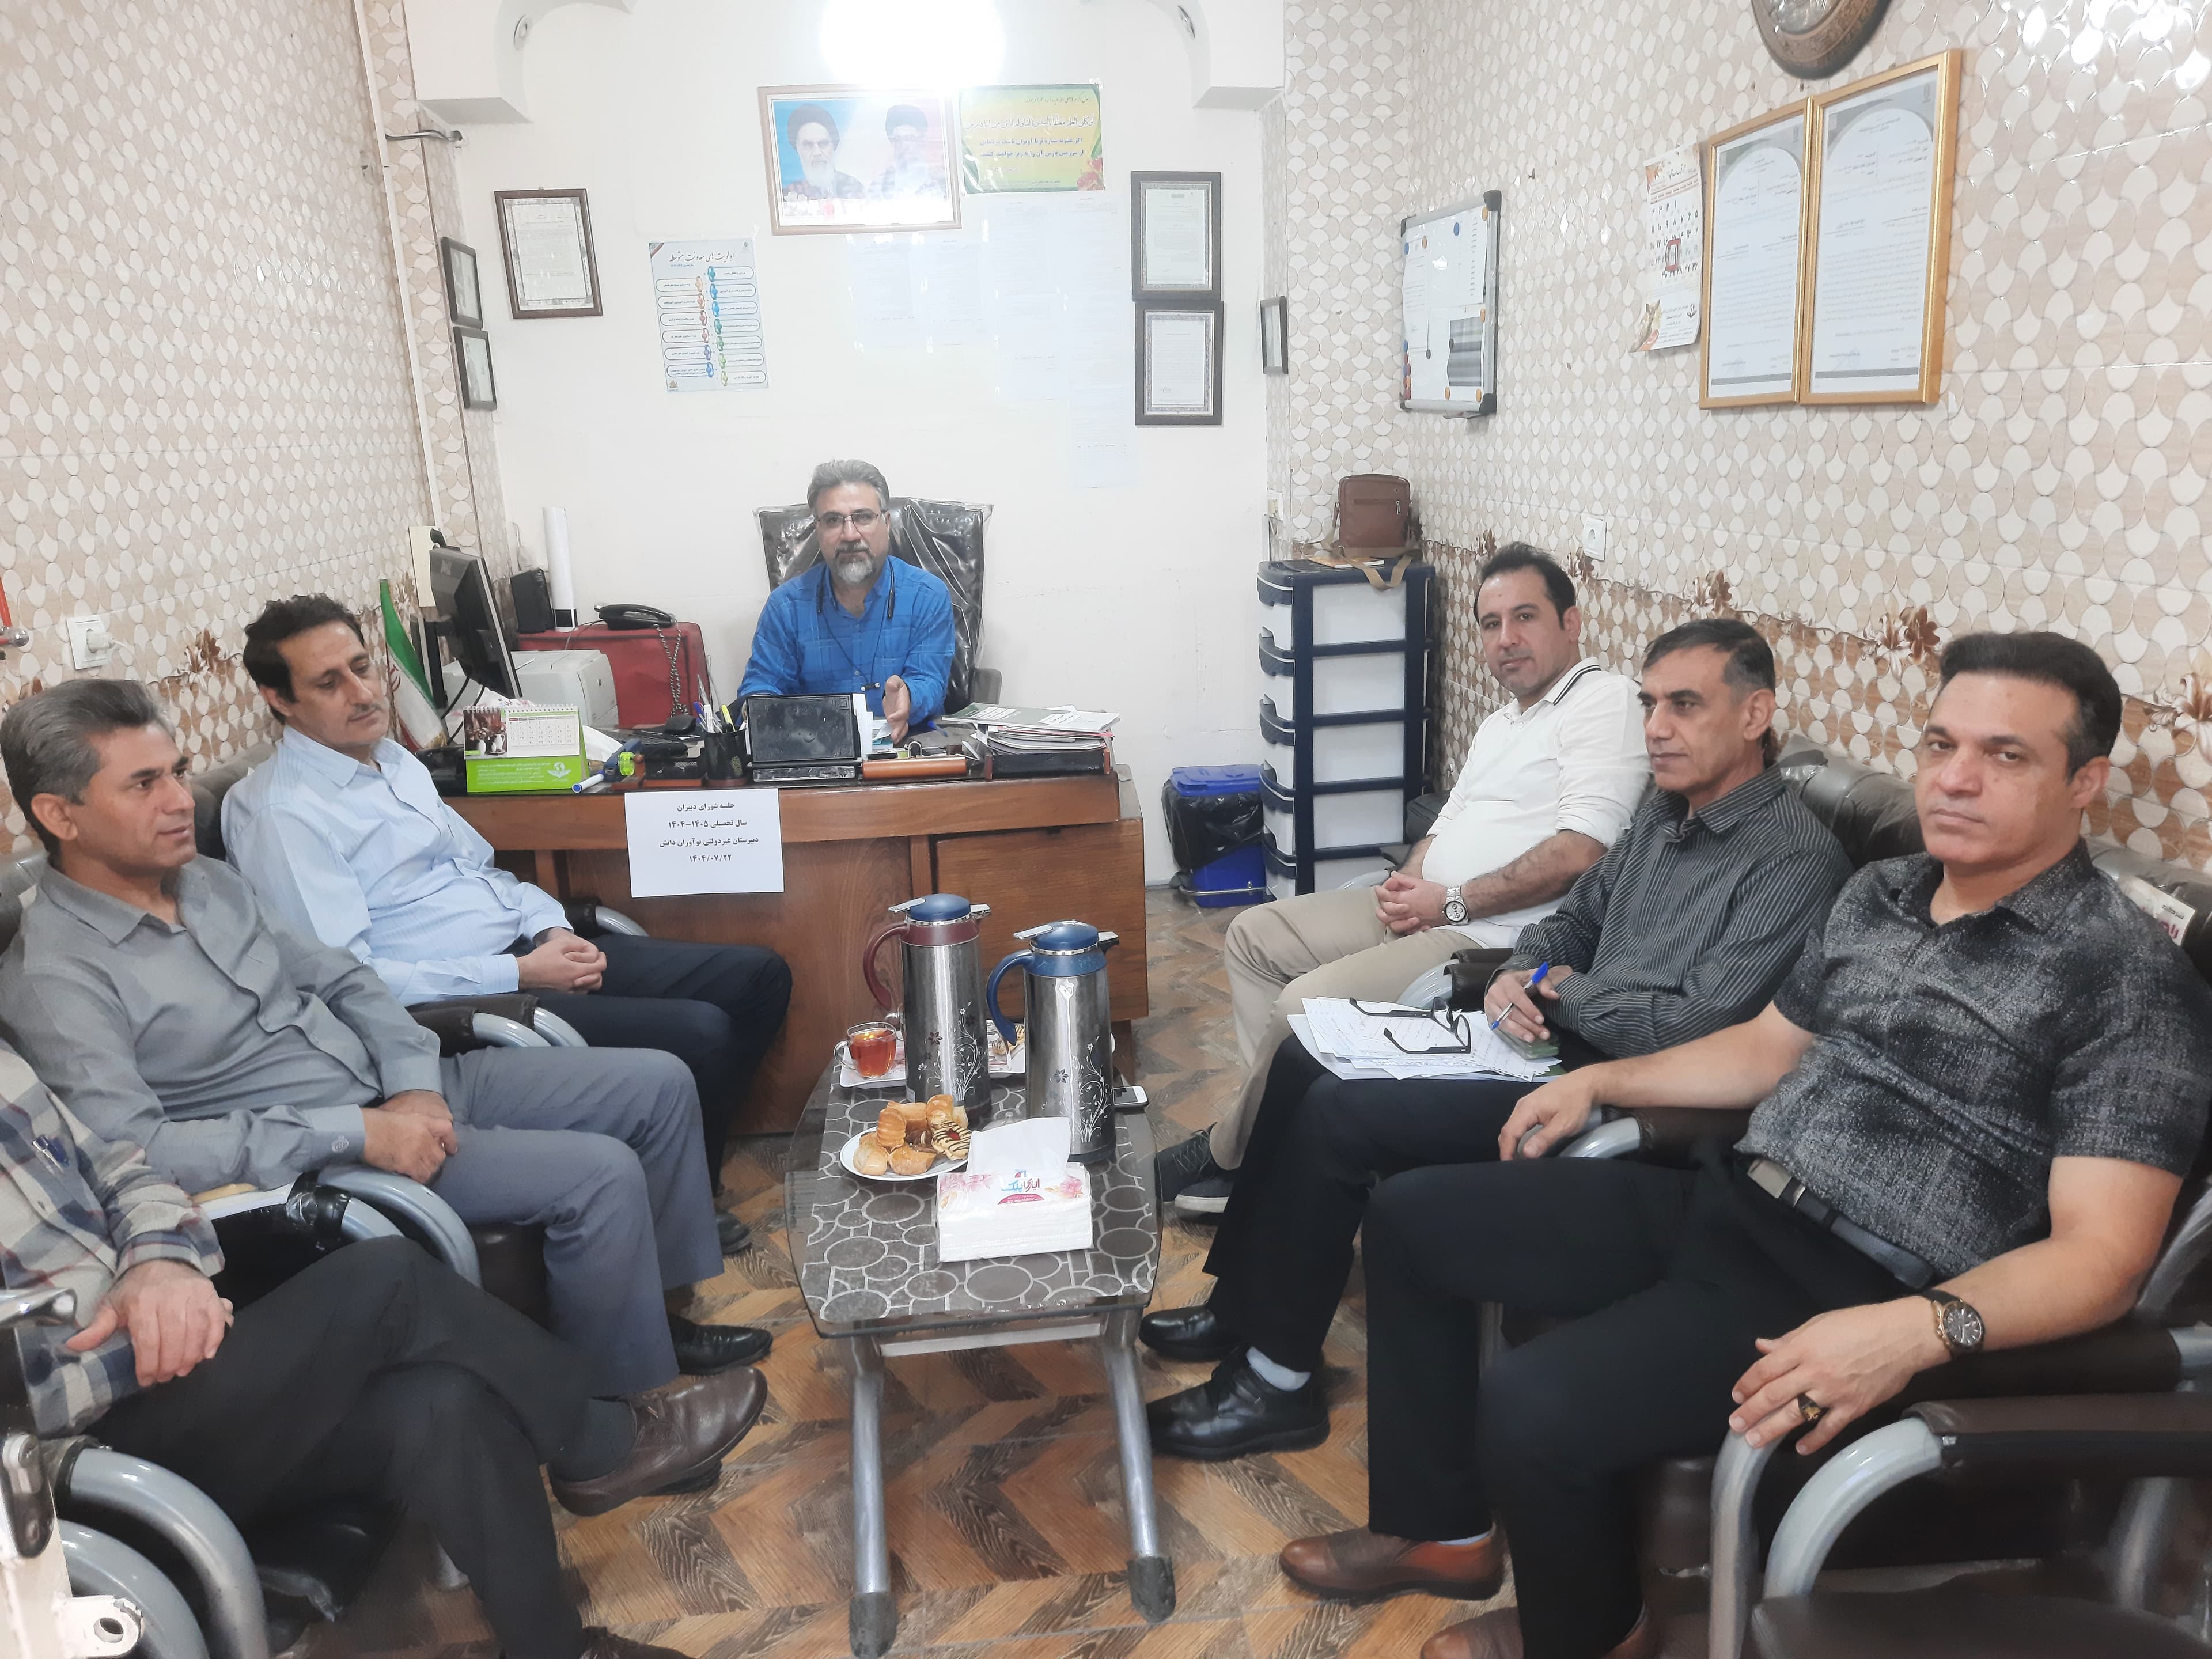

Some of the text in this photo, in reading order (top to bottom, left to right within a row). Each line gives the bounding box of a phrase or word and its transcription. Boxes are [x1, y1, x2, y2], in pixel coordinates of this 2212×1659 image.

[677, 802, 735, 812] جلسه شورای دبیران
[710, 819, 734, 828] تحصیلی
[735, 819, 747, 827] سال
[659, 839, 676, 847] دانش
[732, 836, 759, 845] دبیرستان
[689, 854, 732, 862] ۱۴۰۴/۰۷/۲۲
[1023, 1177, 1040, 1192] ایزی
